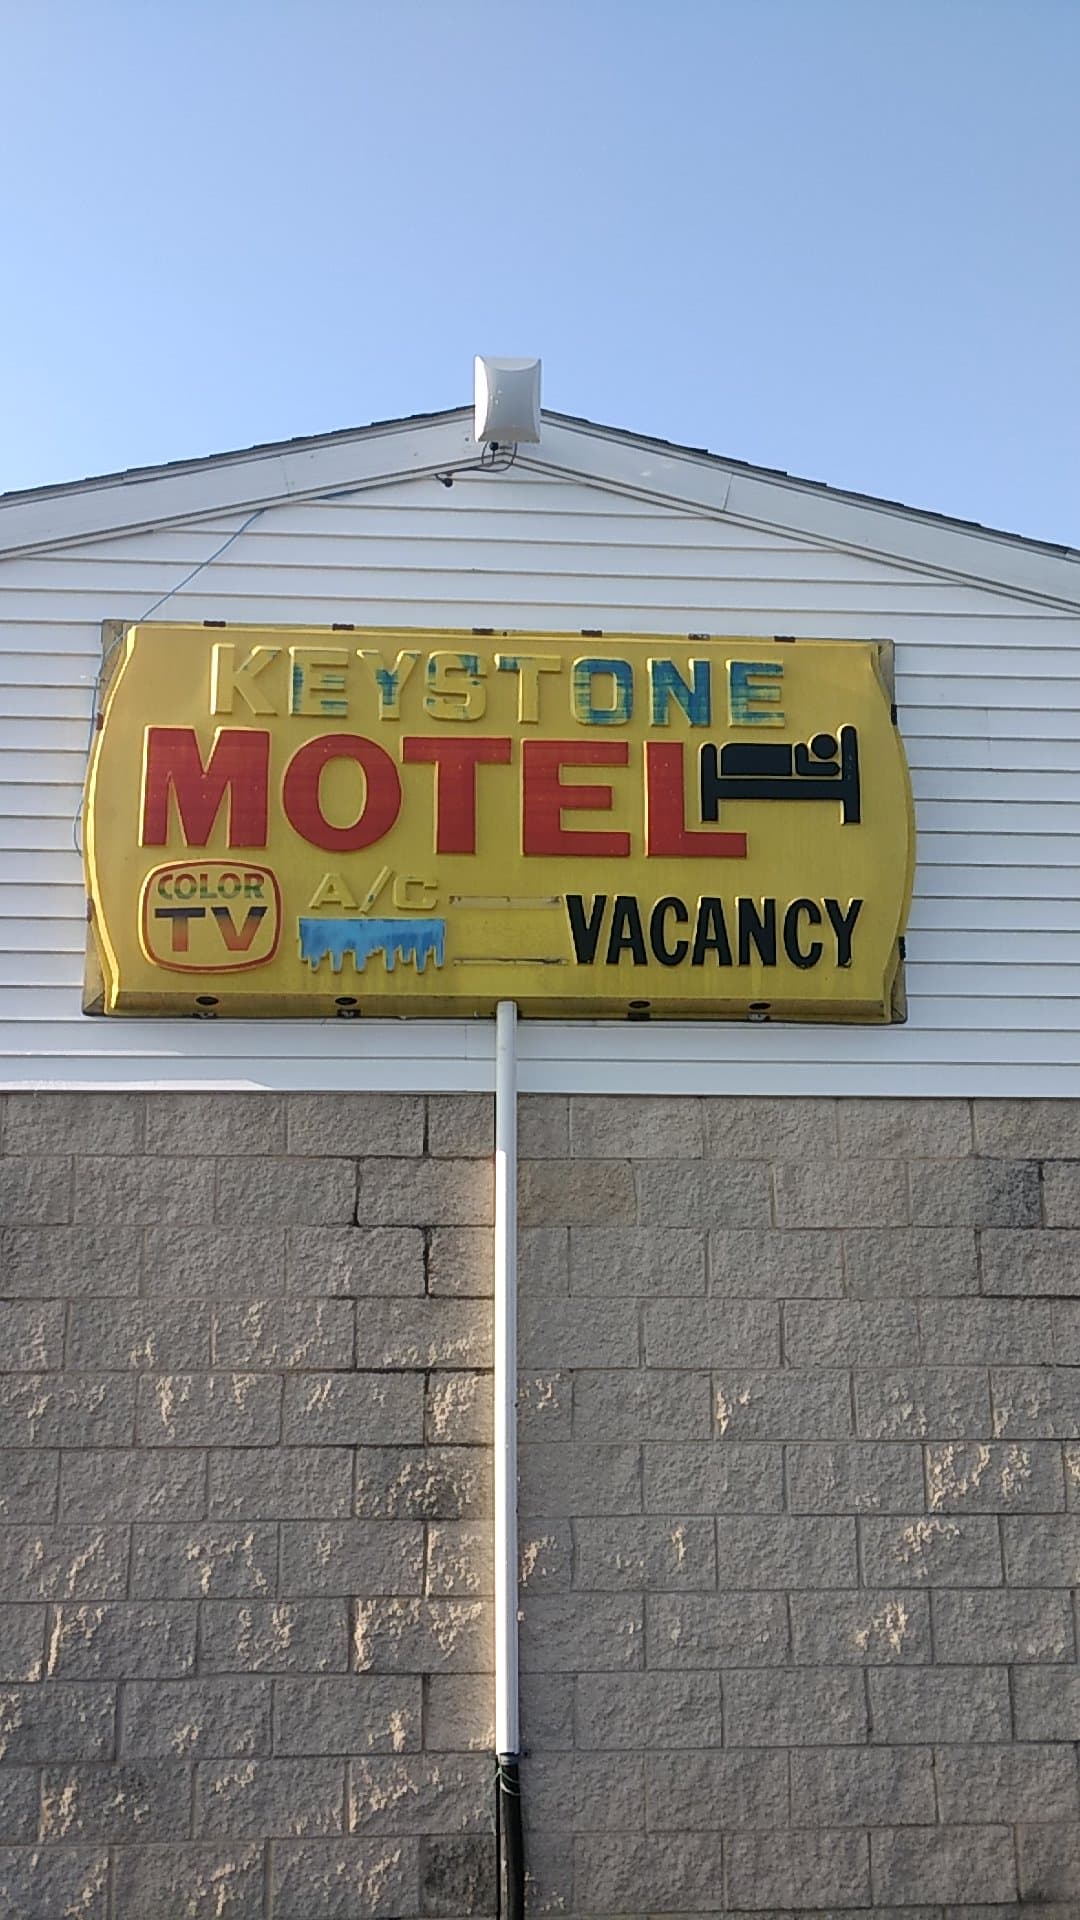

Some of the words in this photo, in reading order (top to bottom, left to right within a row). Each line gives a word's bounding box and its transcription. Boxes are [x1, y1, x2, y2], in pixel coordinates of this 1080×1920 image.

[210, 643, 786, 728] KEYSTONE
[138, 725, 748, 860] MOTEL
[157, 872, 265, 900] COLOR
[308, 865, 438, 914] A/C
[154, 905, 268, 953] TV
[564, 894, 864, 969] VACANCY
